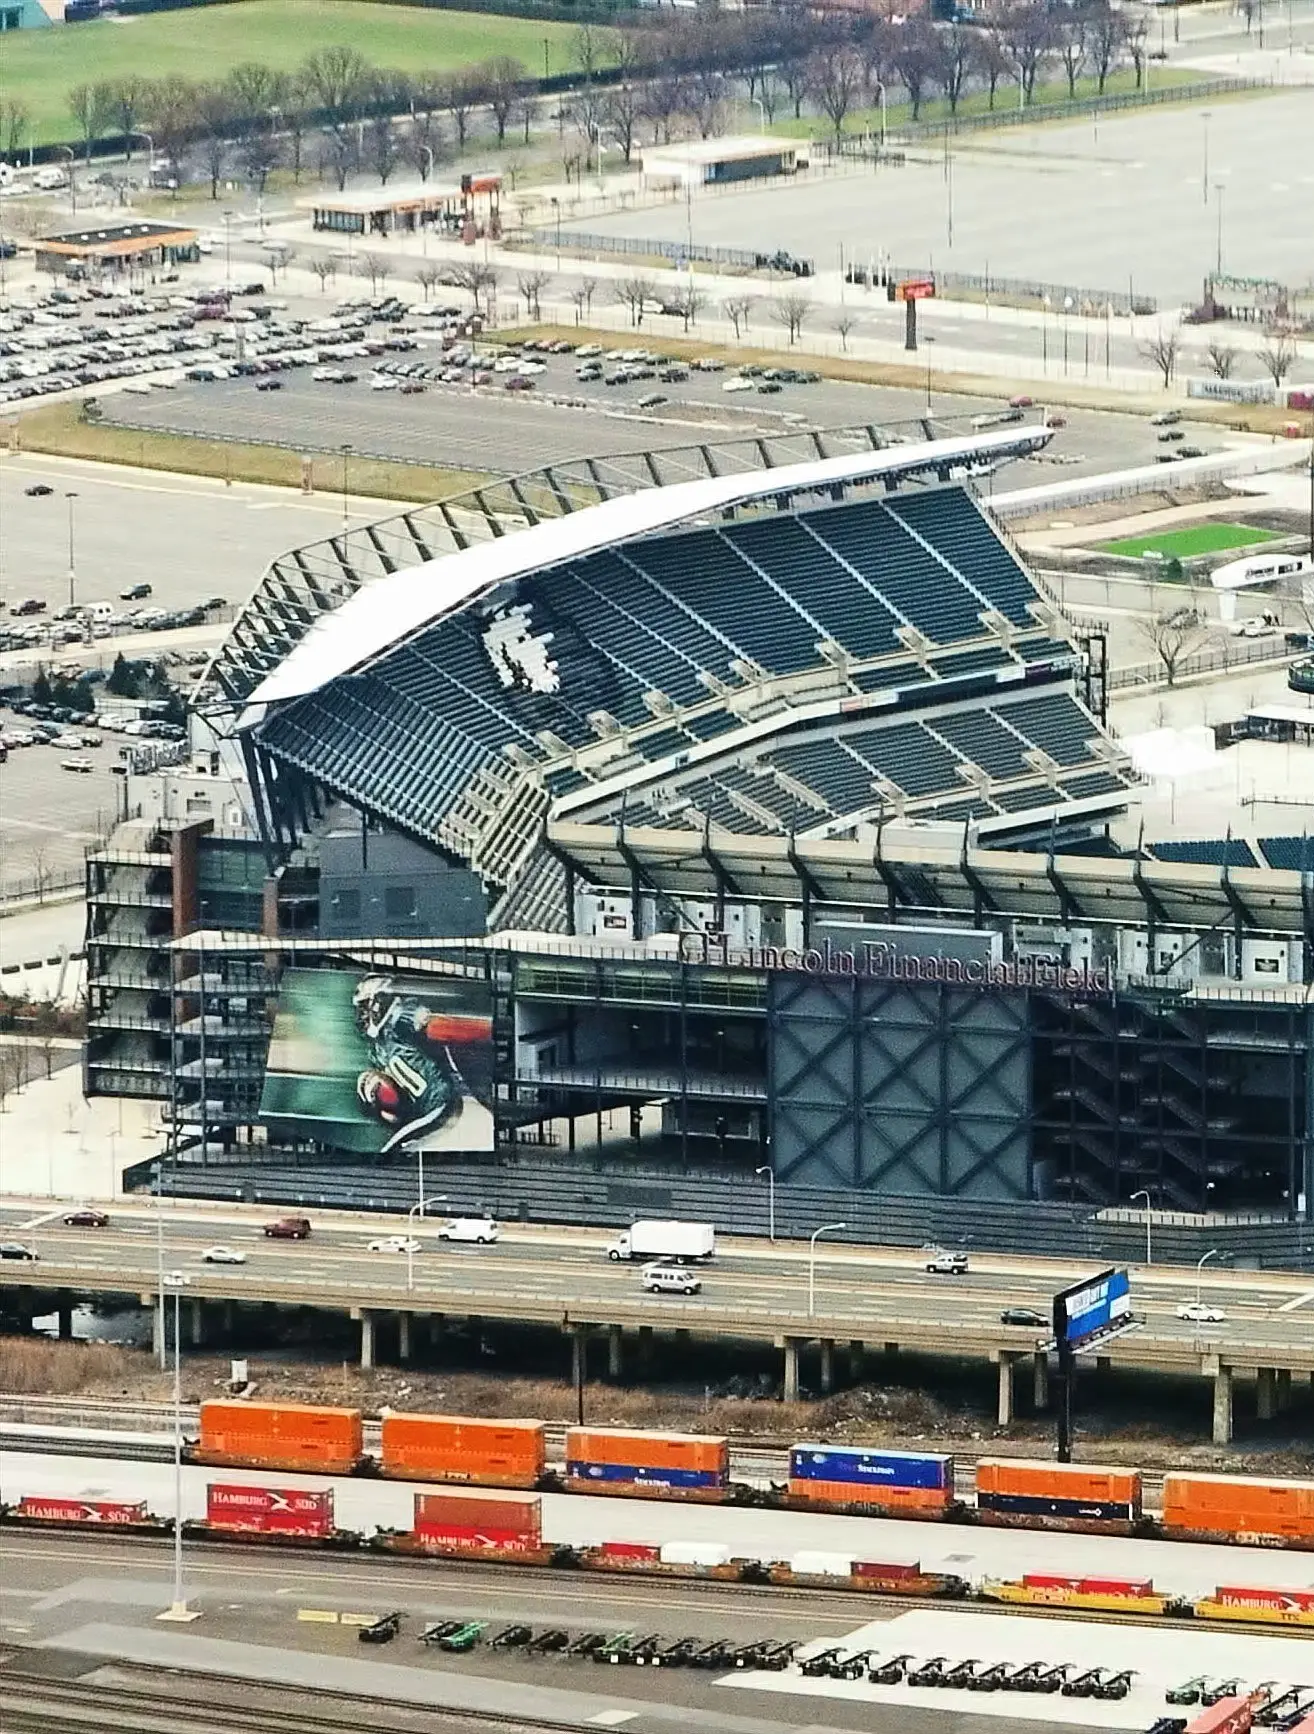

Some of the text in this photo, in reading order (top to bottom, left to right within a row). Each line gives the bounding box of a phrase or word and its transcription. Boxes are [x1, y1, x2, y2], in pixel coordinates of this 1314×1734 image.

[719, 931, 1114, 991] Lincoln Financial Field
[212, 1492, 317, 1510] HAMBURG SÜD
[27, 1505, 130, 1522] HAMBURG SÜD
[1222, 1595, 1279, 1609] HAMBURG
